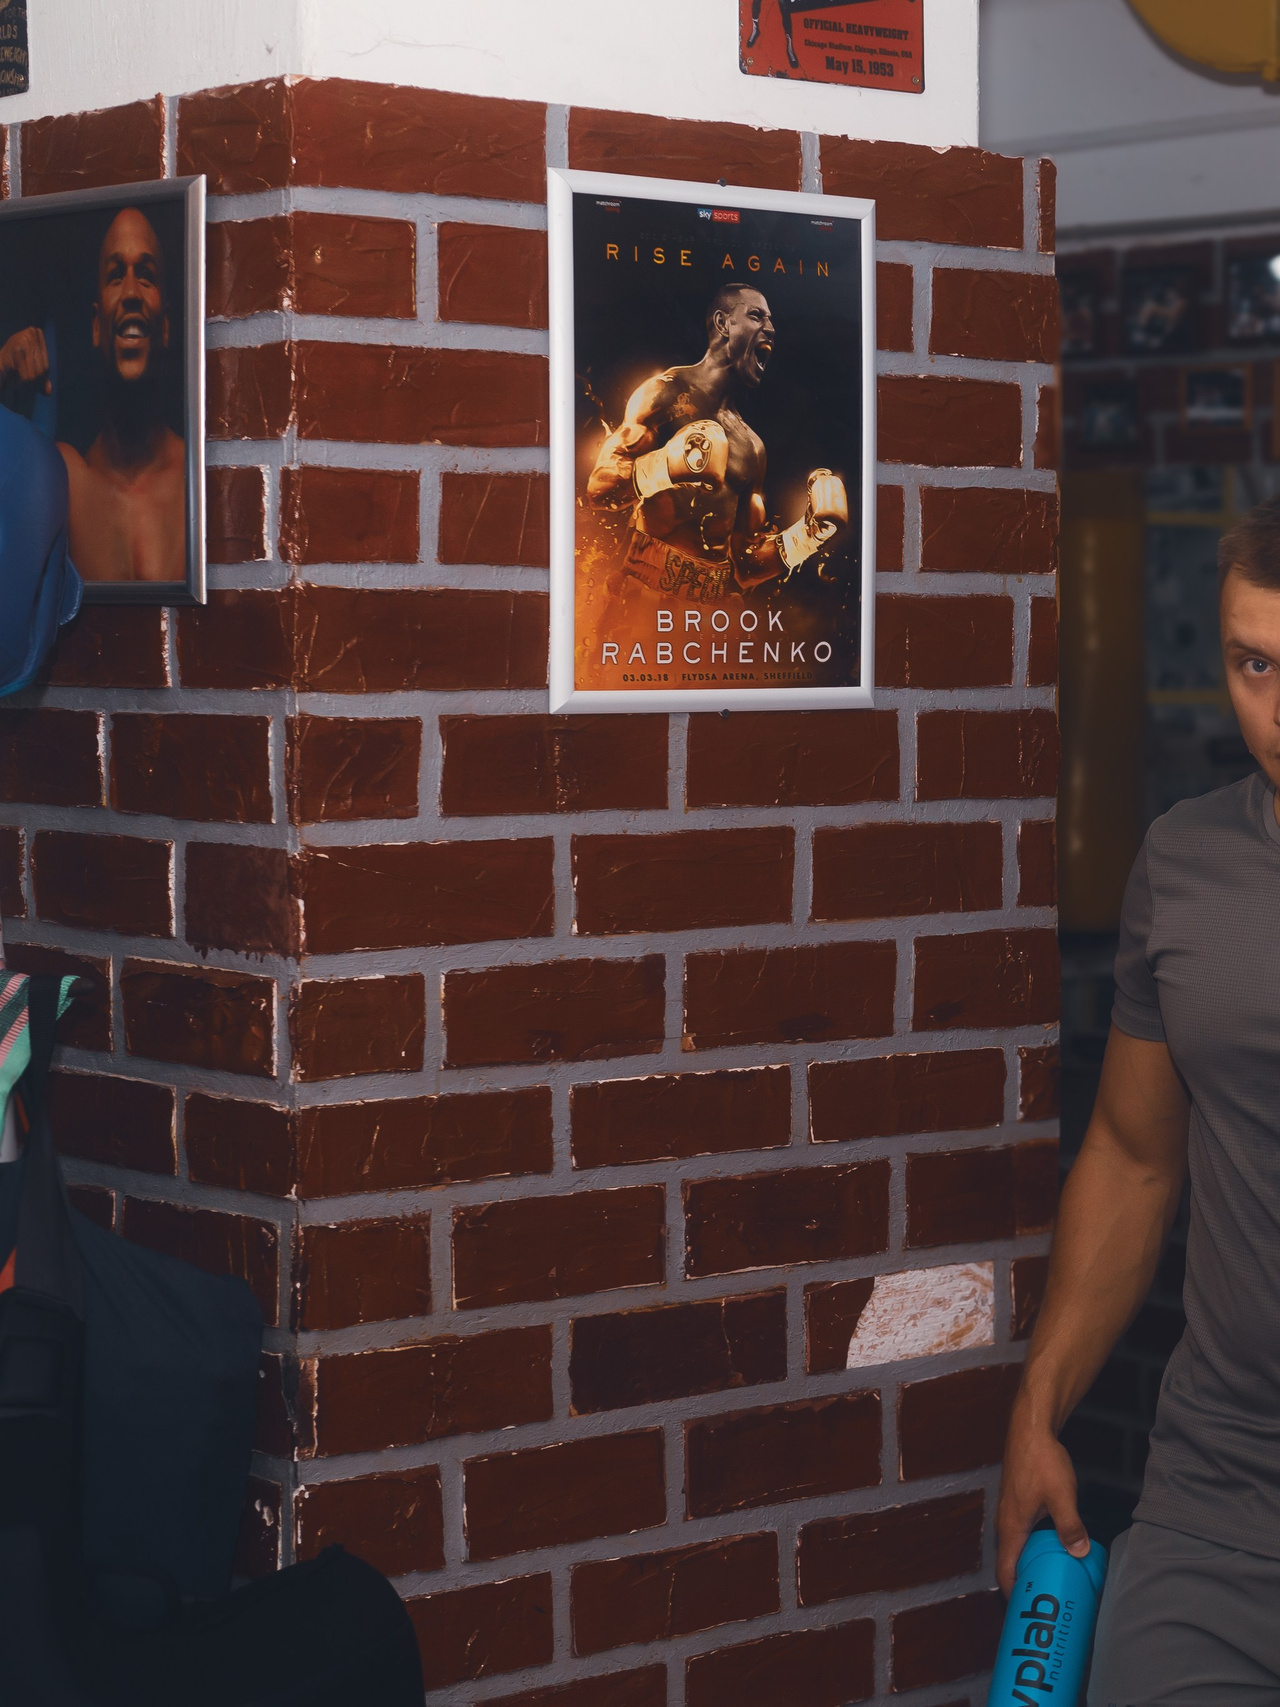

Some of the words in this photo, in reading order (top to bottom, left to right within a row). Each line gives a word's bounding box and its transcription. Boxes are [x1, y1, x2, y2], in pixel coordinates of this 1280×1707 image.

[803, 18, 844, 33] OFFICIAL
[846, 23, 909, 40] HEAVYWEIGHT
[825, 56, 849, 75] May
[851, 59, 866, 75] 15,
[868, 61, 894, 77] 1953
[699, 209, 711, 220] sky
[713, 211, 739, 221] sports
[606, 243, 692, 267] RISE
[721, 253, 829, 277] AGAIN
[656, 610, 785, 632] BROOK
[601, 641, 832, 665] RABCHENKO
[622, 673, 669, 682] 03.03.18
[682, 673, 717, 681] FLYDSA
[763, 672, 813, 680] SHEFFIELD
[1049, 1600, 1076, 1681] nutrition
